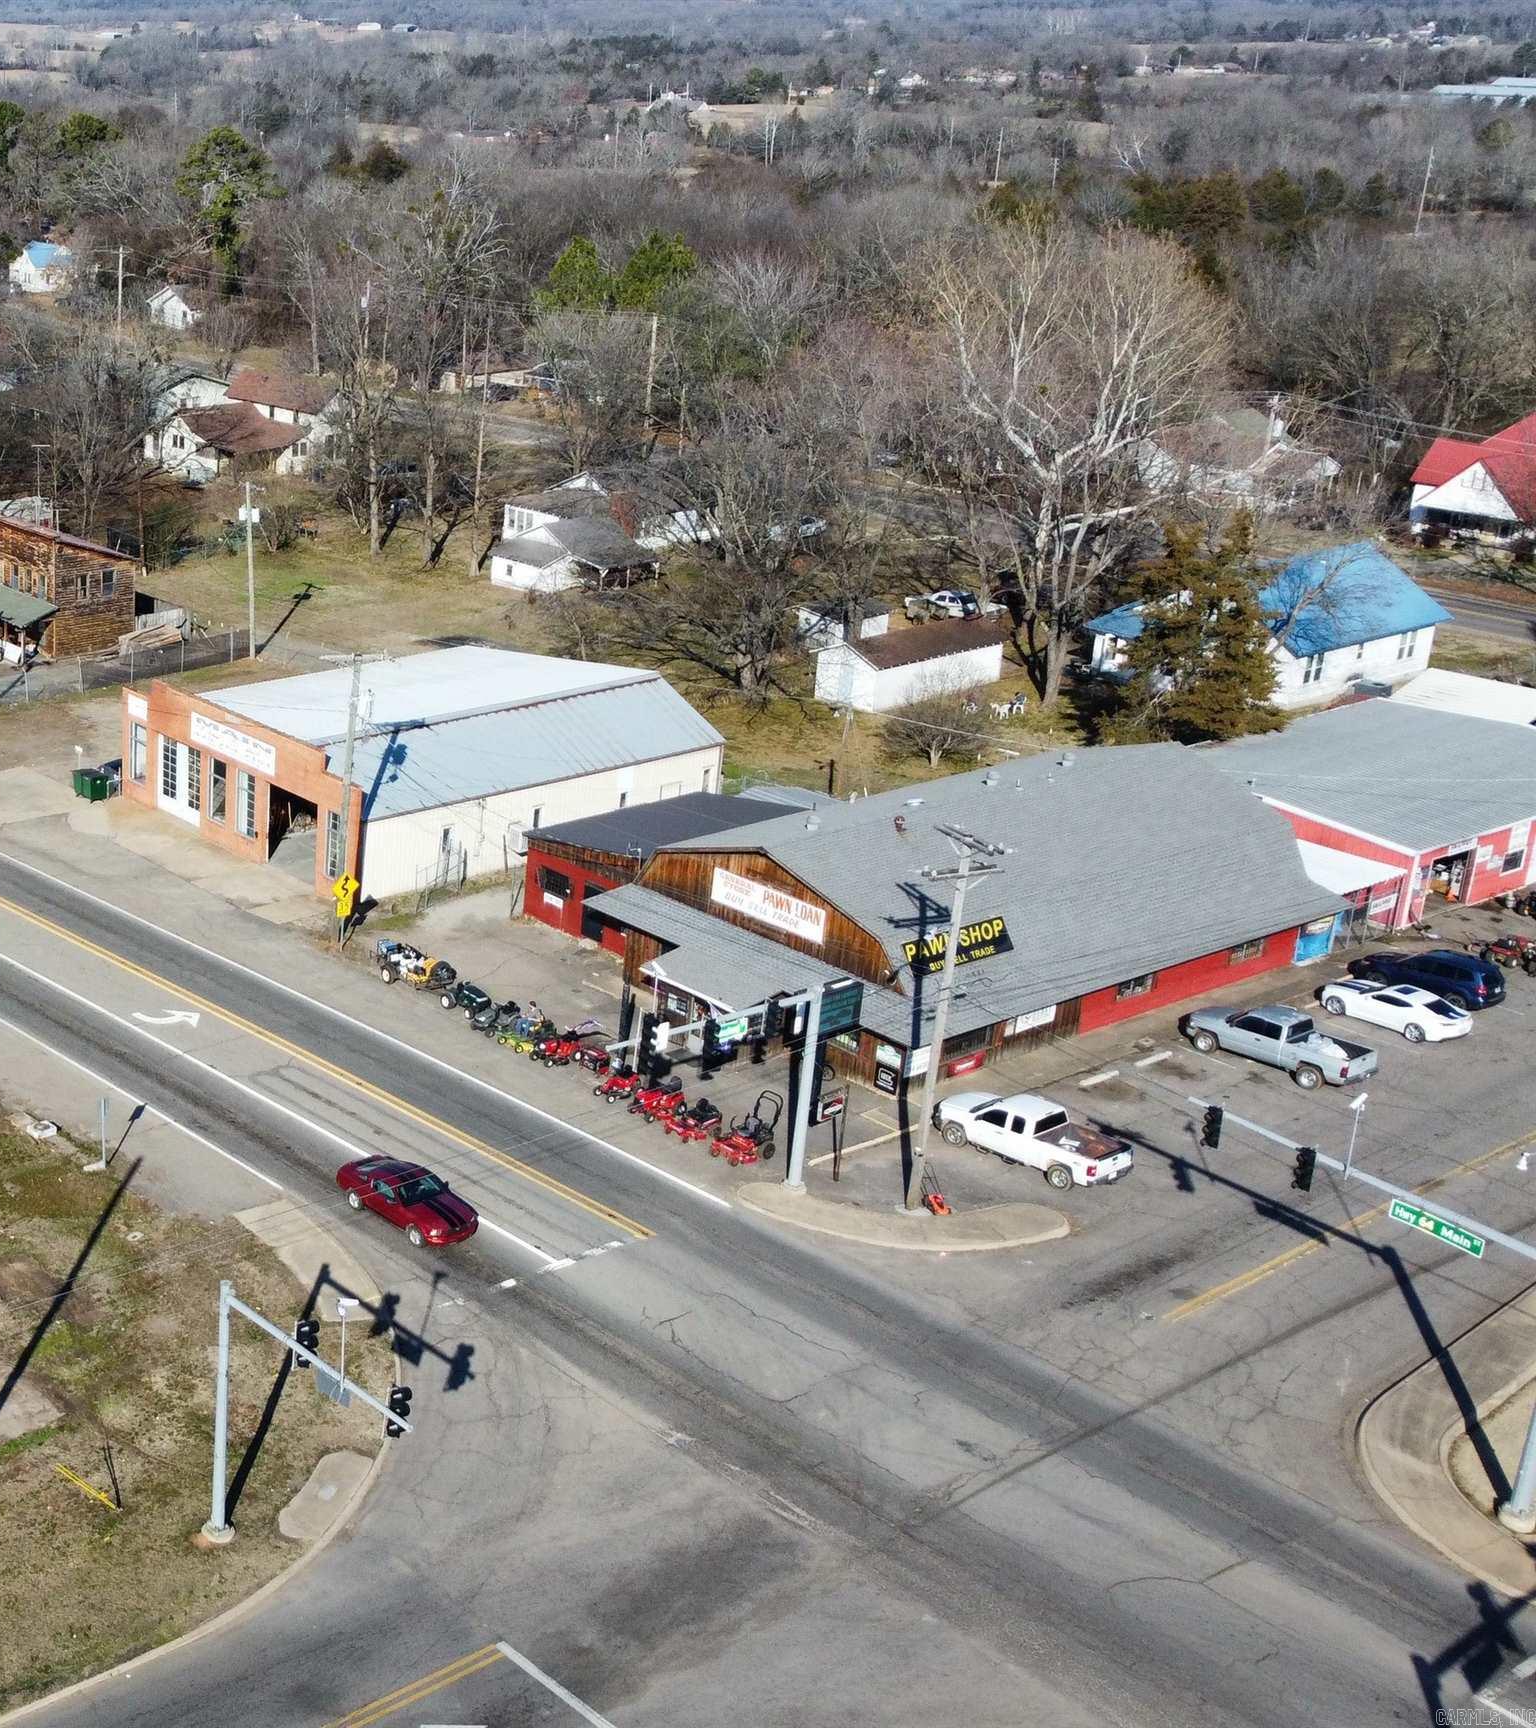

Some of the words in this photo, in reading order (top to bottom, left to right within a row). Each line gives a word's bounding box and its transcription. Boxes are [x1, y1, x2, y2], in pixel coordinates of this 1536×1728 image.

[762, 889, 793, 915] PAWN
[794, 901, 823, 927] LOAN
[958, 919, 1004, 947] SHOP
[929, 958, 945, 971] BUY
[970, 945, 996, 960] TRADE
[1394, 1205, 1416, 1224] Hwy
[1418, 1216, 1435, 1231] 64
[1440, 1225, 1471, 1249] Main
